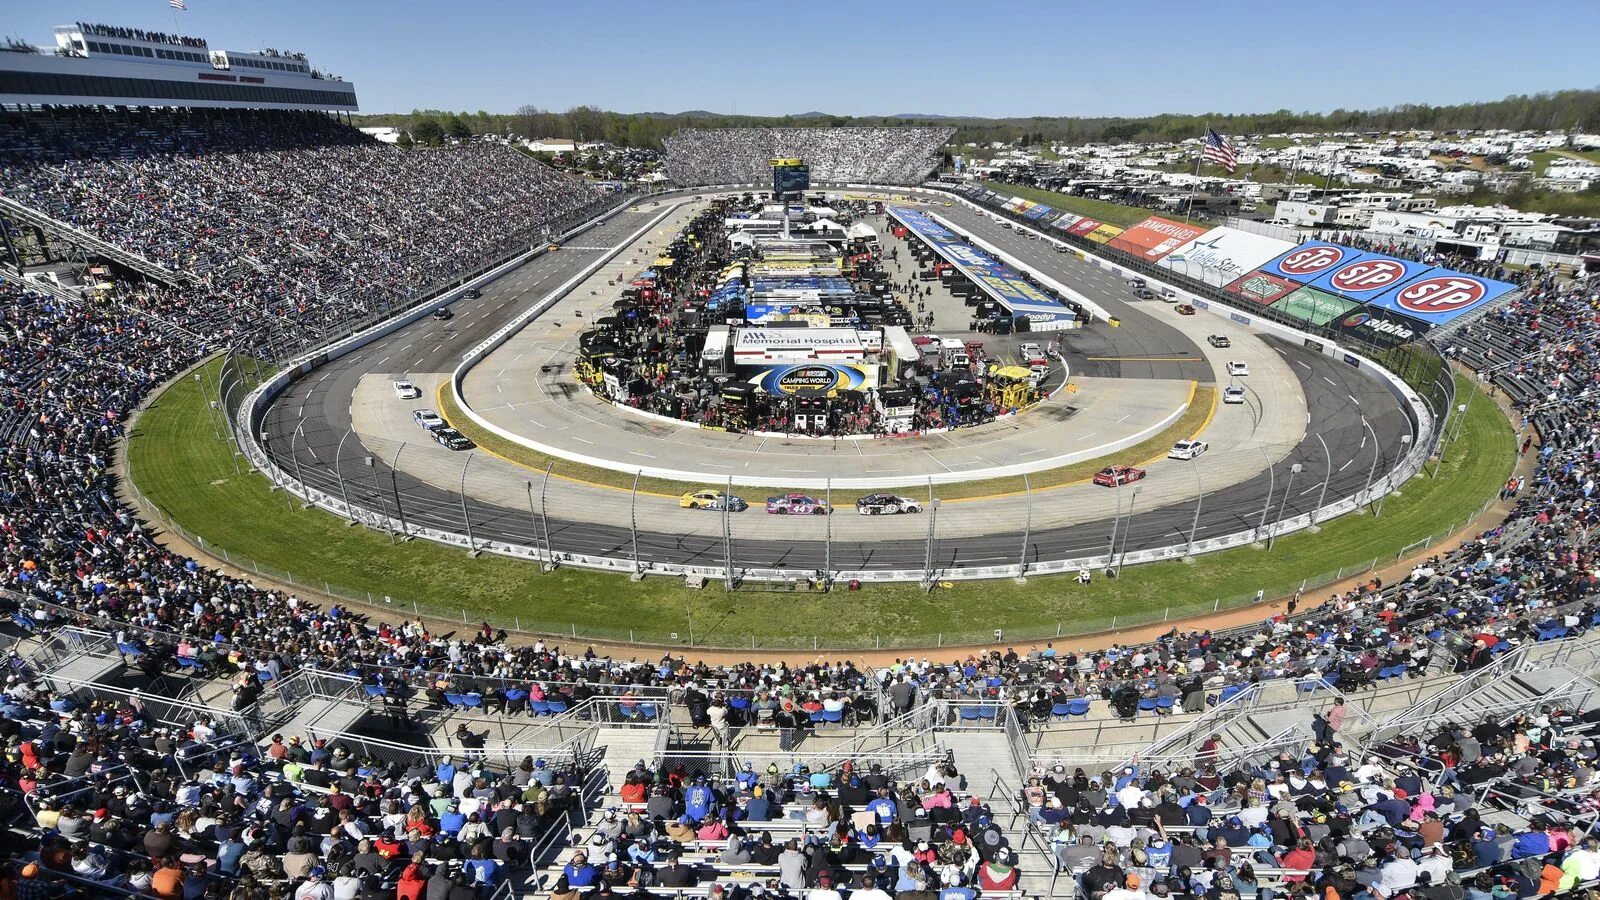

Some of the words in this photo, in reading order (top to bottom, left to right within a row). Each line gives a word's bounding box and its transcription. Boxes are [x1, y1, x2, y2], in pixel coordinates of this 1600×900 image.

[1377, 218, 1393, 226] Sprint
[1284, 247, 1335, 271] STP
[1337, 262, 1397, 287] STP
[1403, 280, 1473, 308] STP
[1024, 313, 1056, 321] Goody's
[1364, 318, 1414, 339] alpha
[804, 337, 857, 345] Hospital
